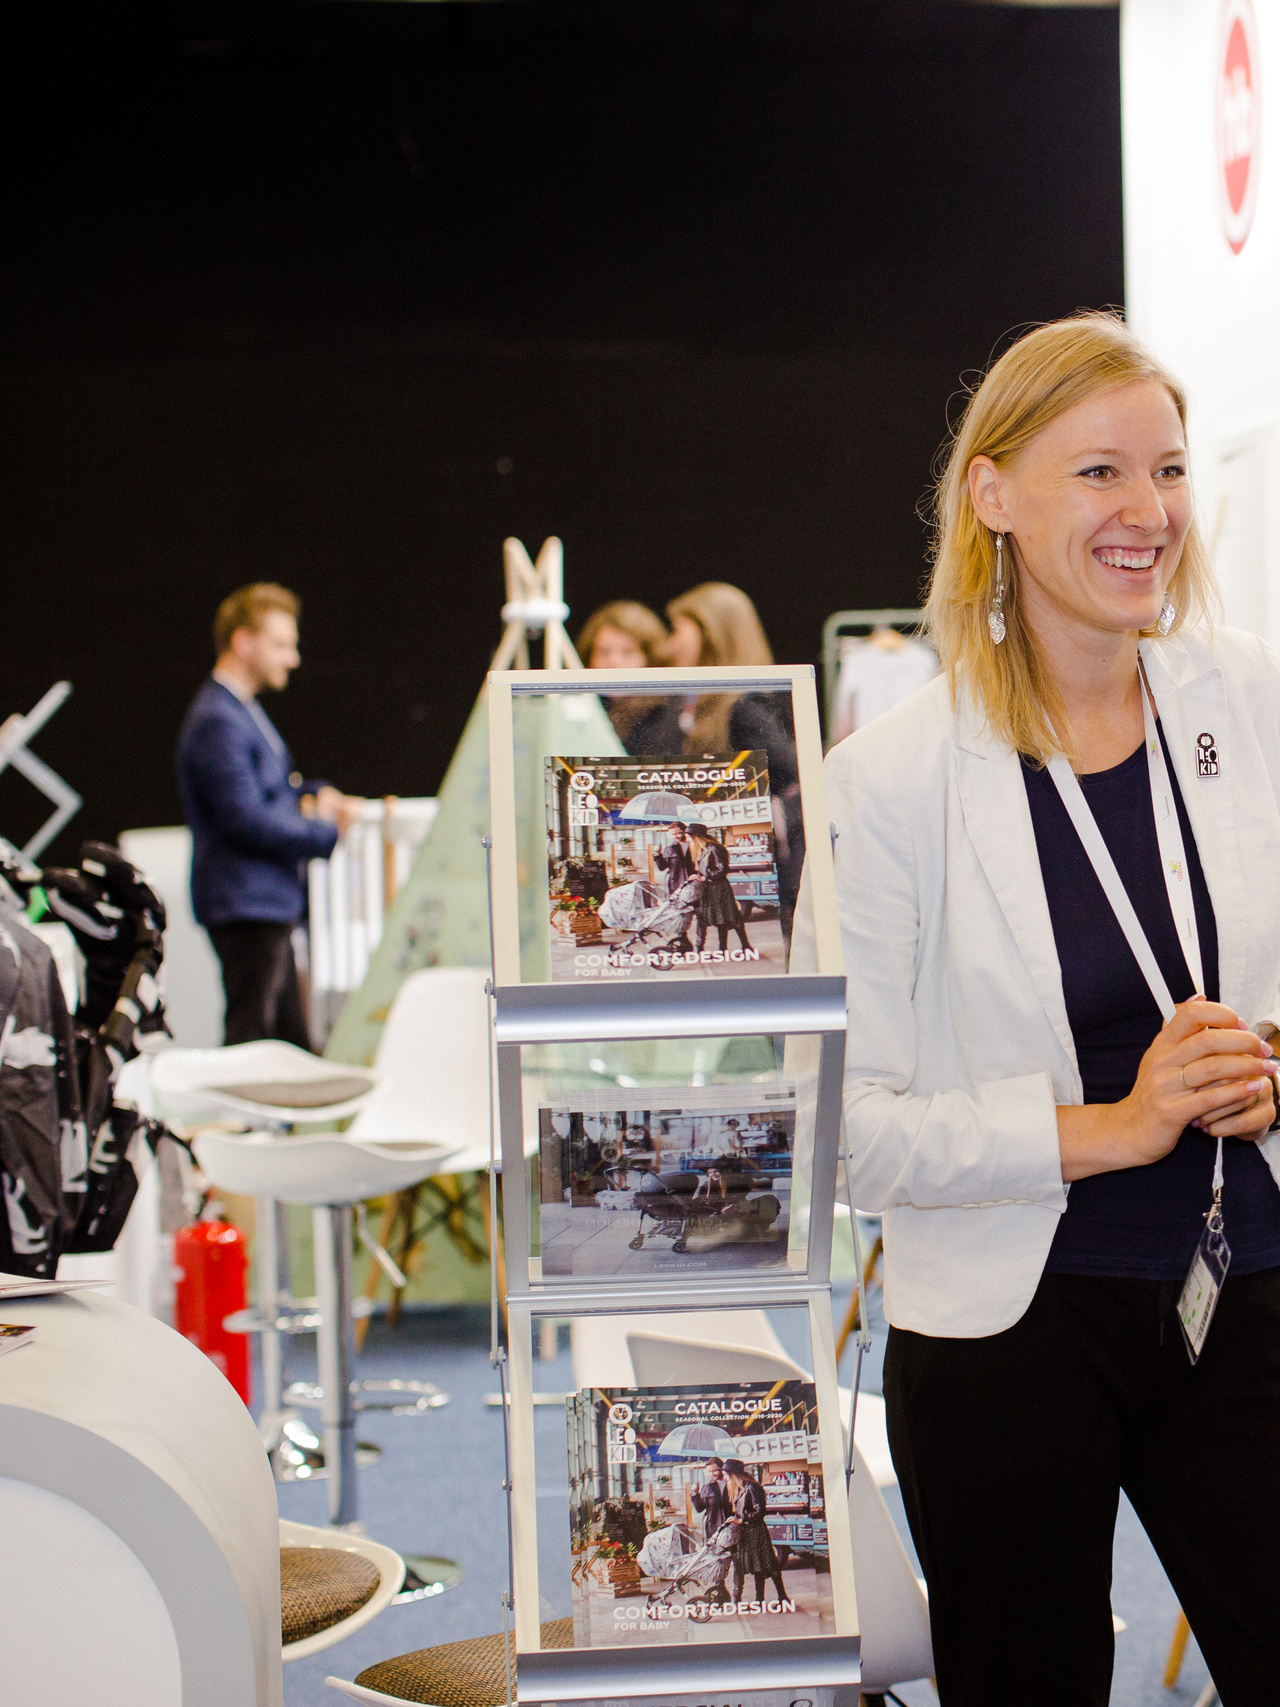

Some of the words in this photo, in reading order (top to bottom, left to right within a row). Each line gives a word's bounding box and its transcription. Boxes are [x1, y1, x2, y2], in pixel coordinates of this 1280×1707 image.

[1198, 749, 1217, 762] LEO
[637, 768, 746, 783] CATALOGUE
[1200, 762, 1218, 775] KID
[572, 810, 598, 825] KID
[574, 948, 760, 968] COMFORT&DESIGN
[574, 968, 599, 977] FOR
[601, 968, 633, 977] BABY
[674, 1398, 782, 1415] CATALOGUE
[611, 1446, 635, 1462] KID
[613, 1599, 796, 1620] COMFORT&DESIGN
[614, 1622, 638, 1631] FOR
[640, 1621, 670, 1630] BABY
